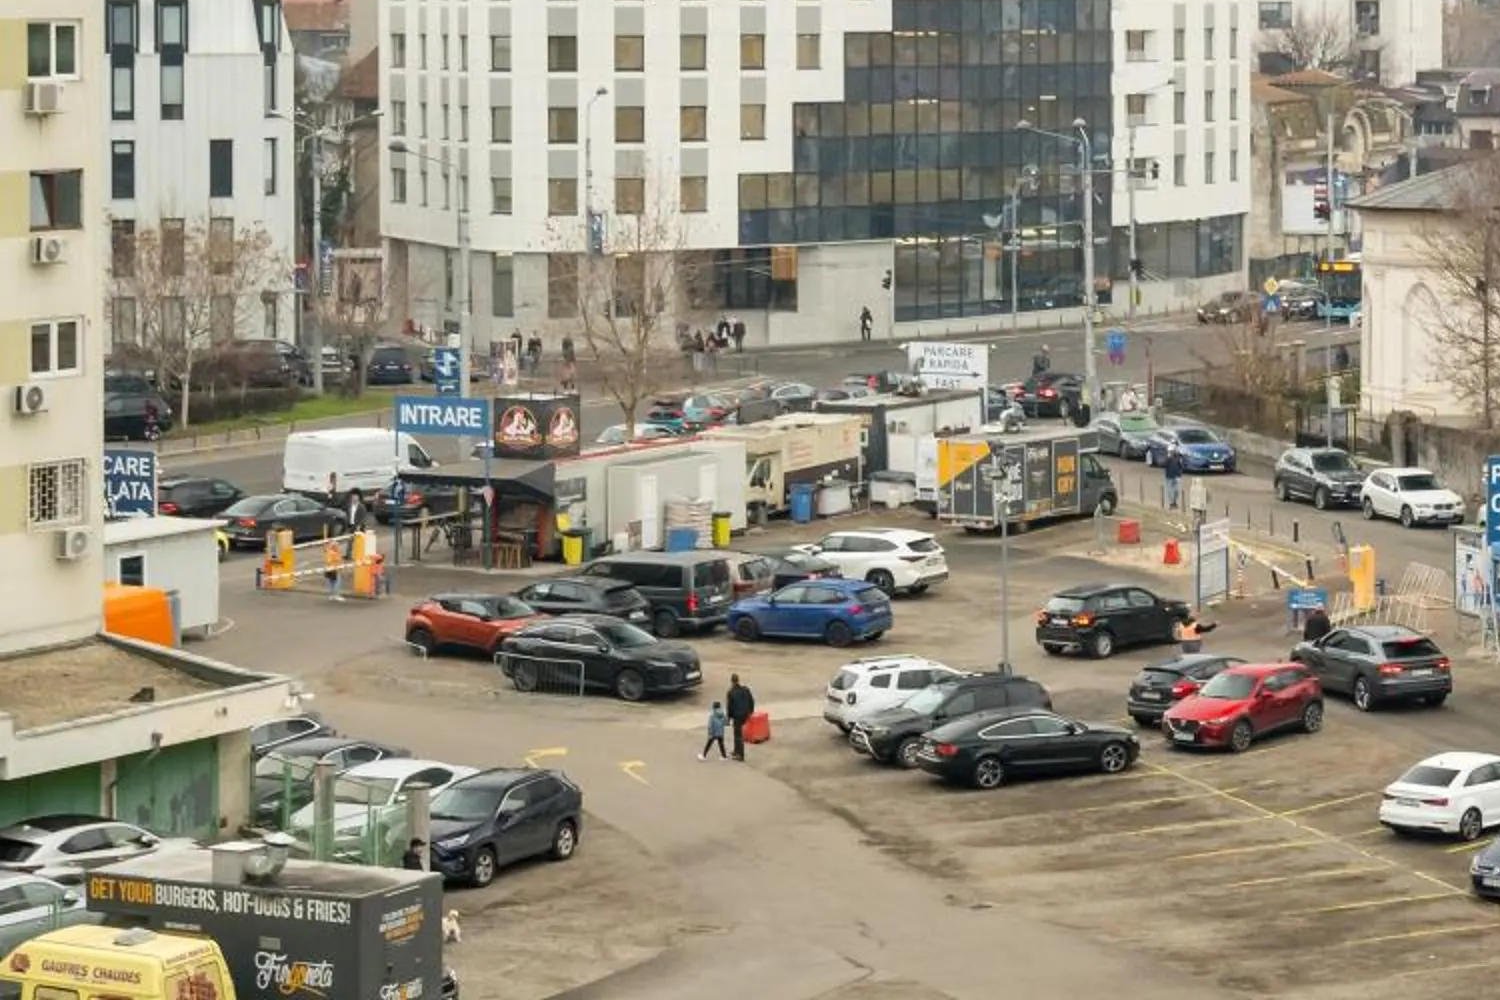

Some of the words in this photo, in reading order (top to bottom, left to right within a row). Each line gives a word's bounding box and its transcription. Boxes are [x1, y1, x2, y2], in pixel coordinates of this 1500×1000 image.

[400, 404, 482, 428] INTRARE
[104, 480, 153, 501] LATA
[90, 877, 116, 900] GET
[119, 879, 153, 904] YOUR
[155, 883, 220, 912] BURGERS,
[293, 898, 303, 919] &
[307, 899, 351, 924] FRIES!
